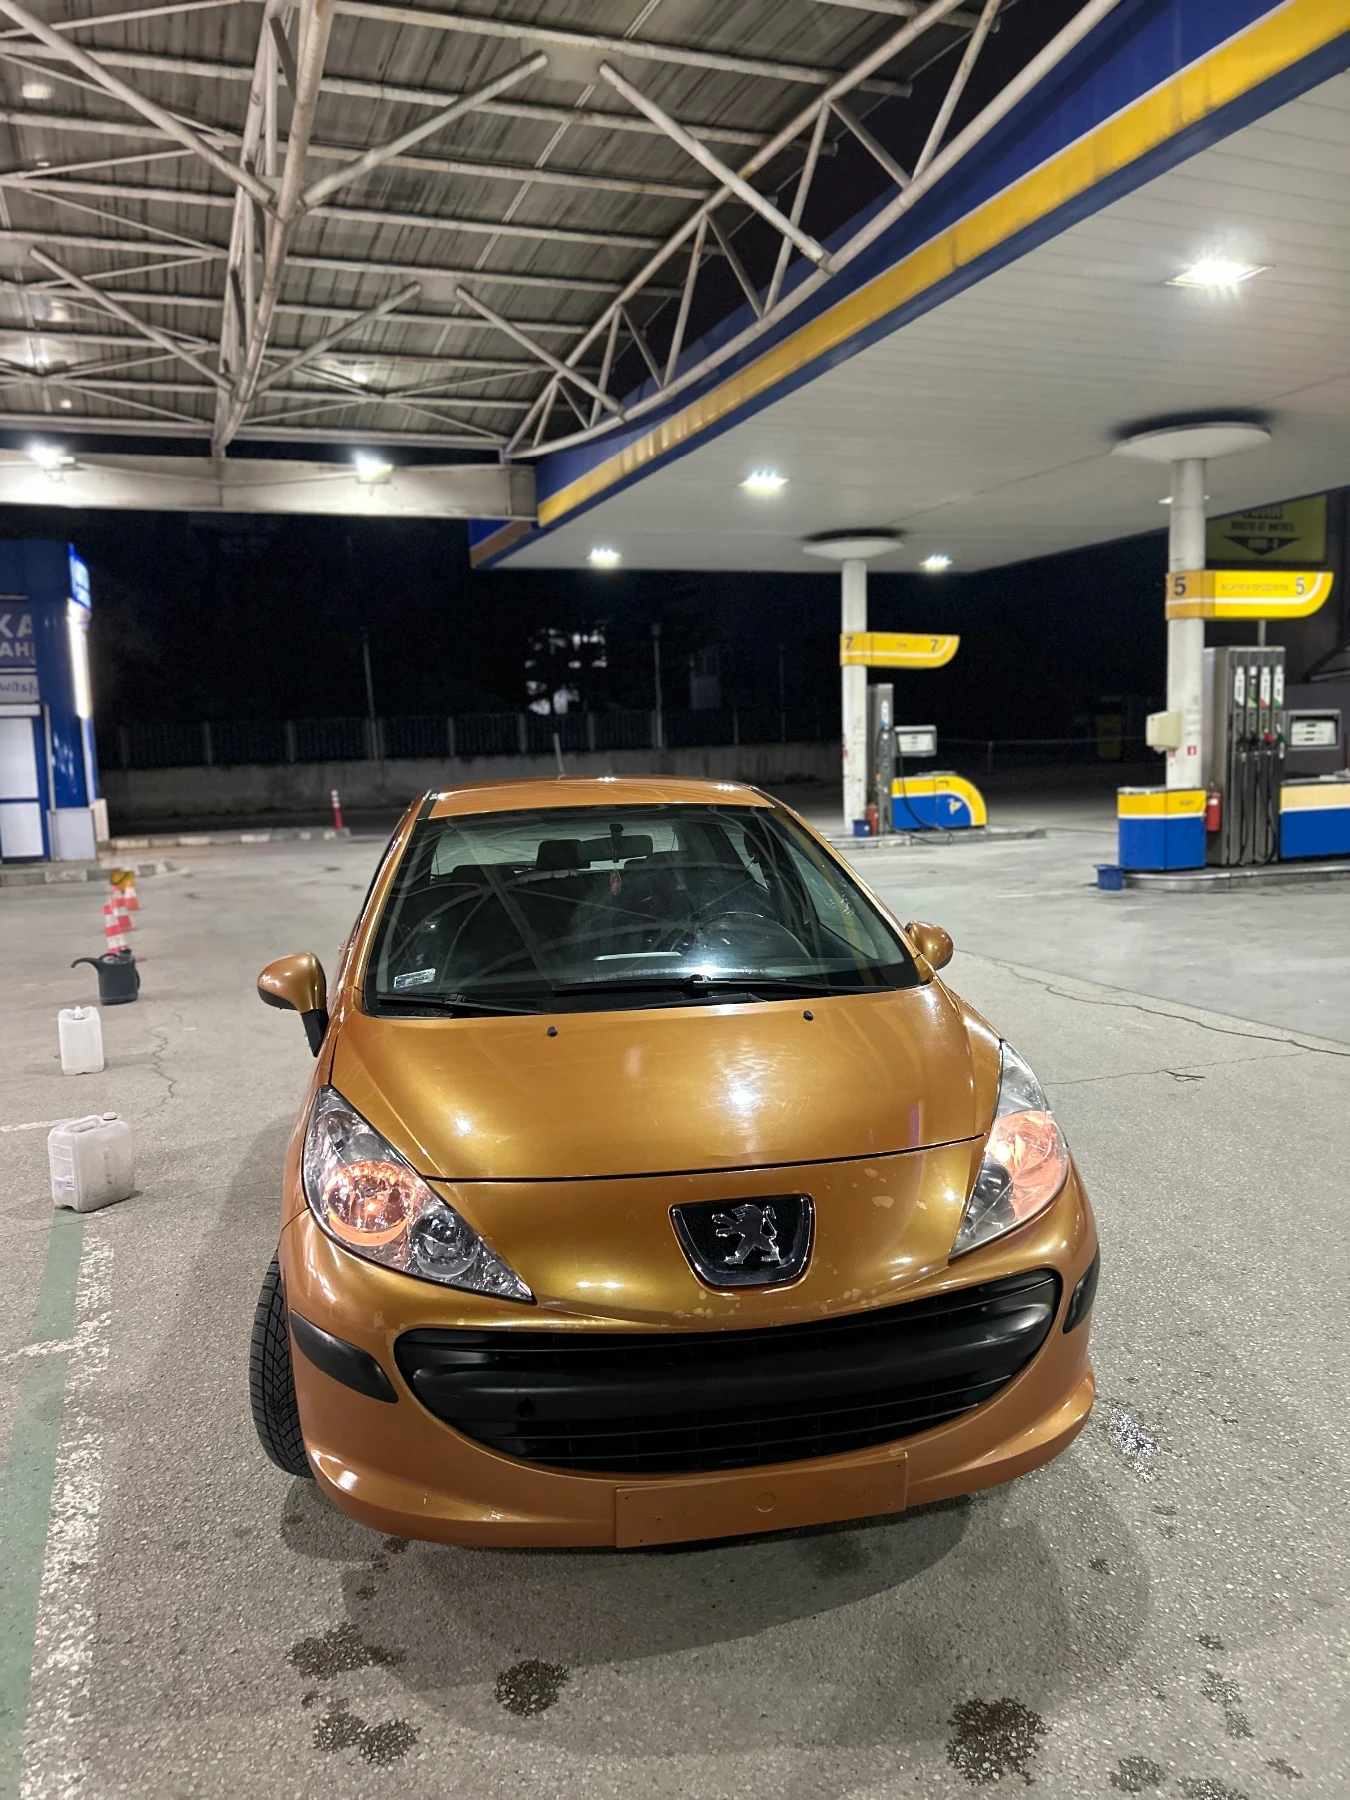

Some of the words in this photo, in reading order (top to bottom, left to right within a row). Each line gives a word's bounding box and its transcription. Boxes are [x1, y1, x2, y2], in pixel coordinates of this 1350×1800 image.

[1174, 576, 1187, 597] 5
[1295, 576, 1306, 596] 5
[845, 636, 854, 650] 7
[930, 638, 939, 653] 7
